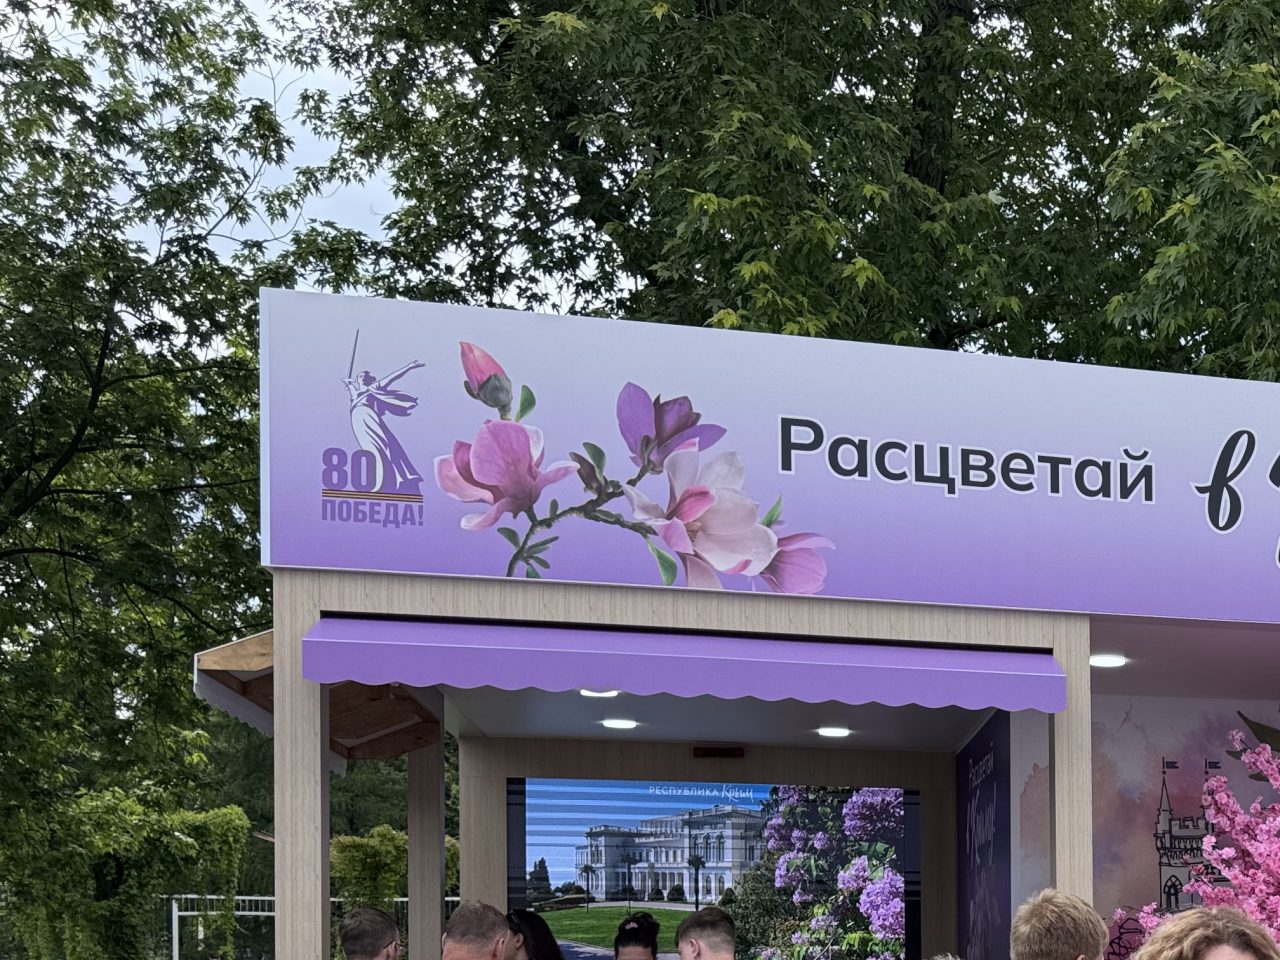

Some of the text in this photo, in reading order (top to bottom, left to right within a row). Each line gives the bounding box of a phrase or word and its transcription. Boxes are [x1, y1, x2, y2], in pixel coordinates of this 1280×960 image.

[322, 447, 377, 491] 80
[780, 416, 1156, 502] Расцветай
[1197, 429, 1256, 531] в
[321, 499, 424, 528] ПОБЕДА!
[648, 786, 720, 796] РЕСПУБЛИКА
